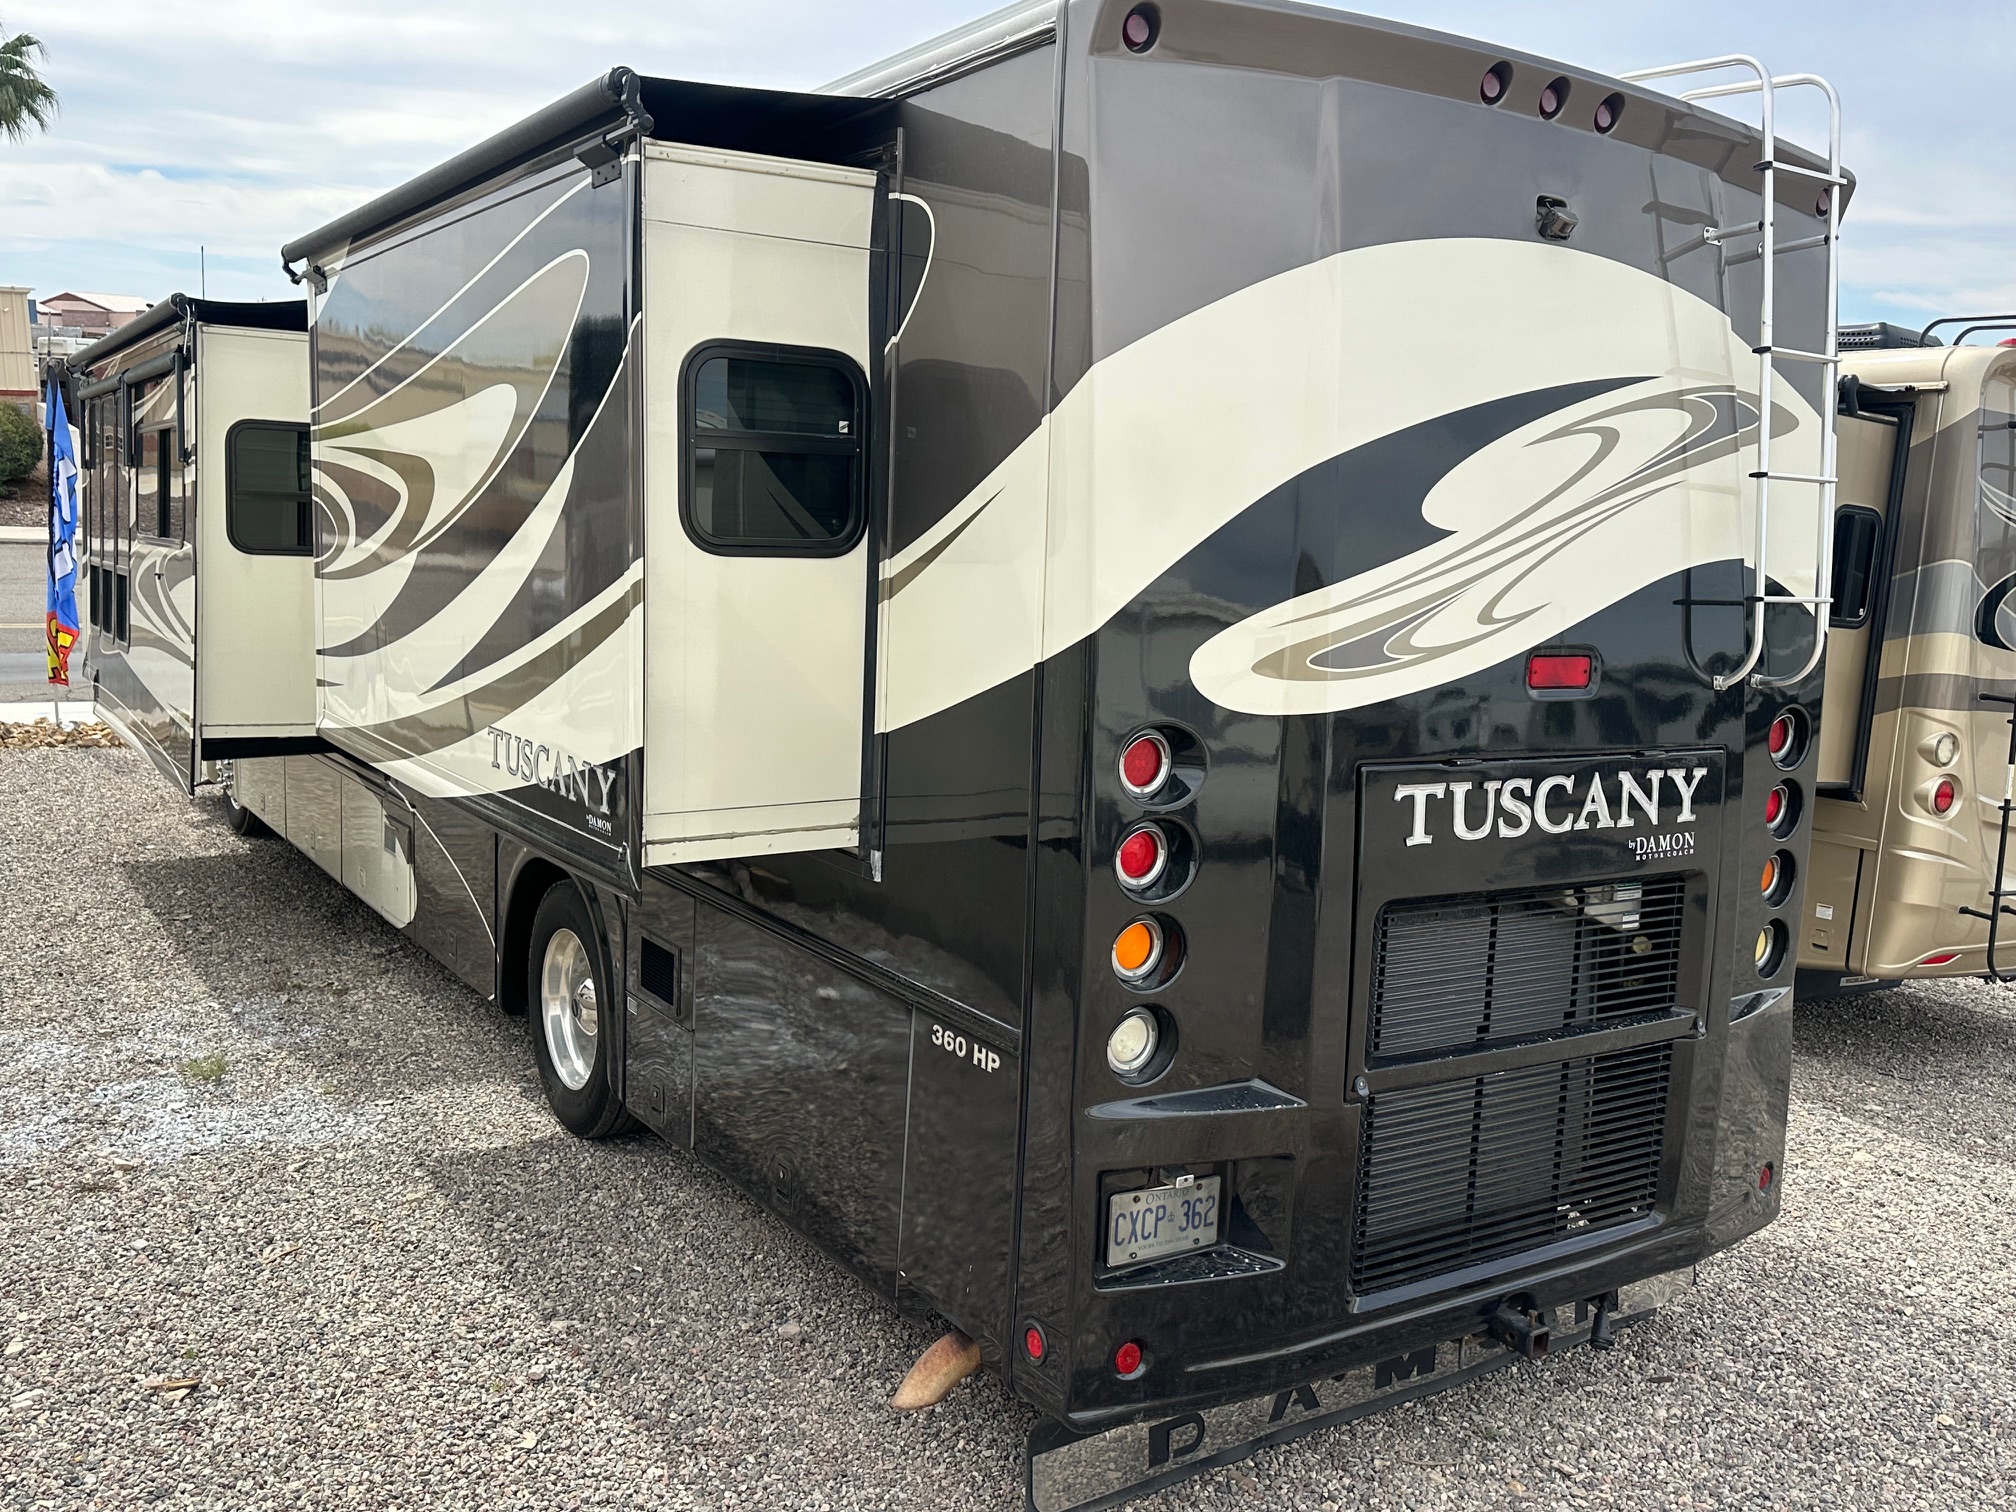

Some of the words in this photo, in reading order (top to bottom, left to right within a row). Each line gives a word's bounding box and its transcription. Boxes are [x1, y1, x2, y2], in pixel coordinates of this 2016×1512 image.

[487, 725, 617, 817] TUSCANY
[588, 814, 612, 833] DAMON
[1393, 767, 1708, 847] TUSCANY
[1628, 839, 1636, 850] by
[1635, 831, 1696, 855] DAMON
[1666, 848, 1695, 858] COACH
[931, 1023, 967, 1058] 360
[972, 1042, 1001, 1074] HP
[1145, 1187, 1190, 1205] ONTARIO
[1114, 1204, 1167, 1247] CXCP
[1178, 1194, 1216, 1233] 362
